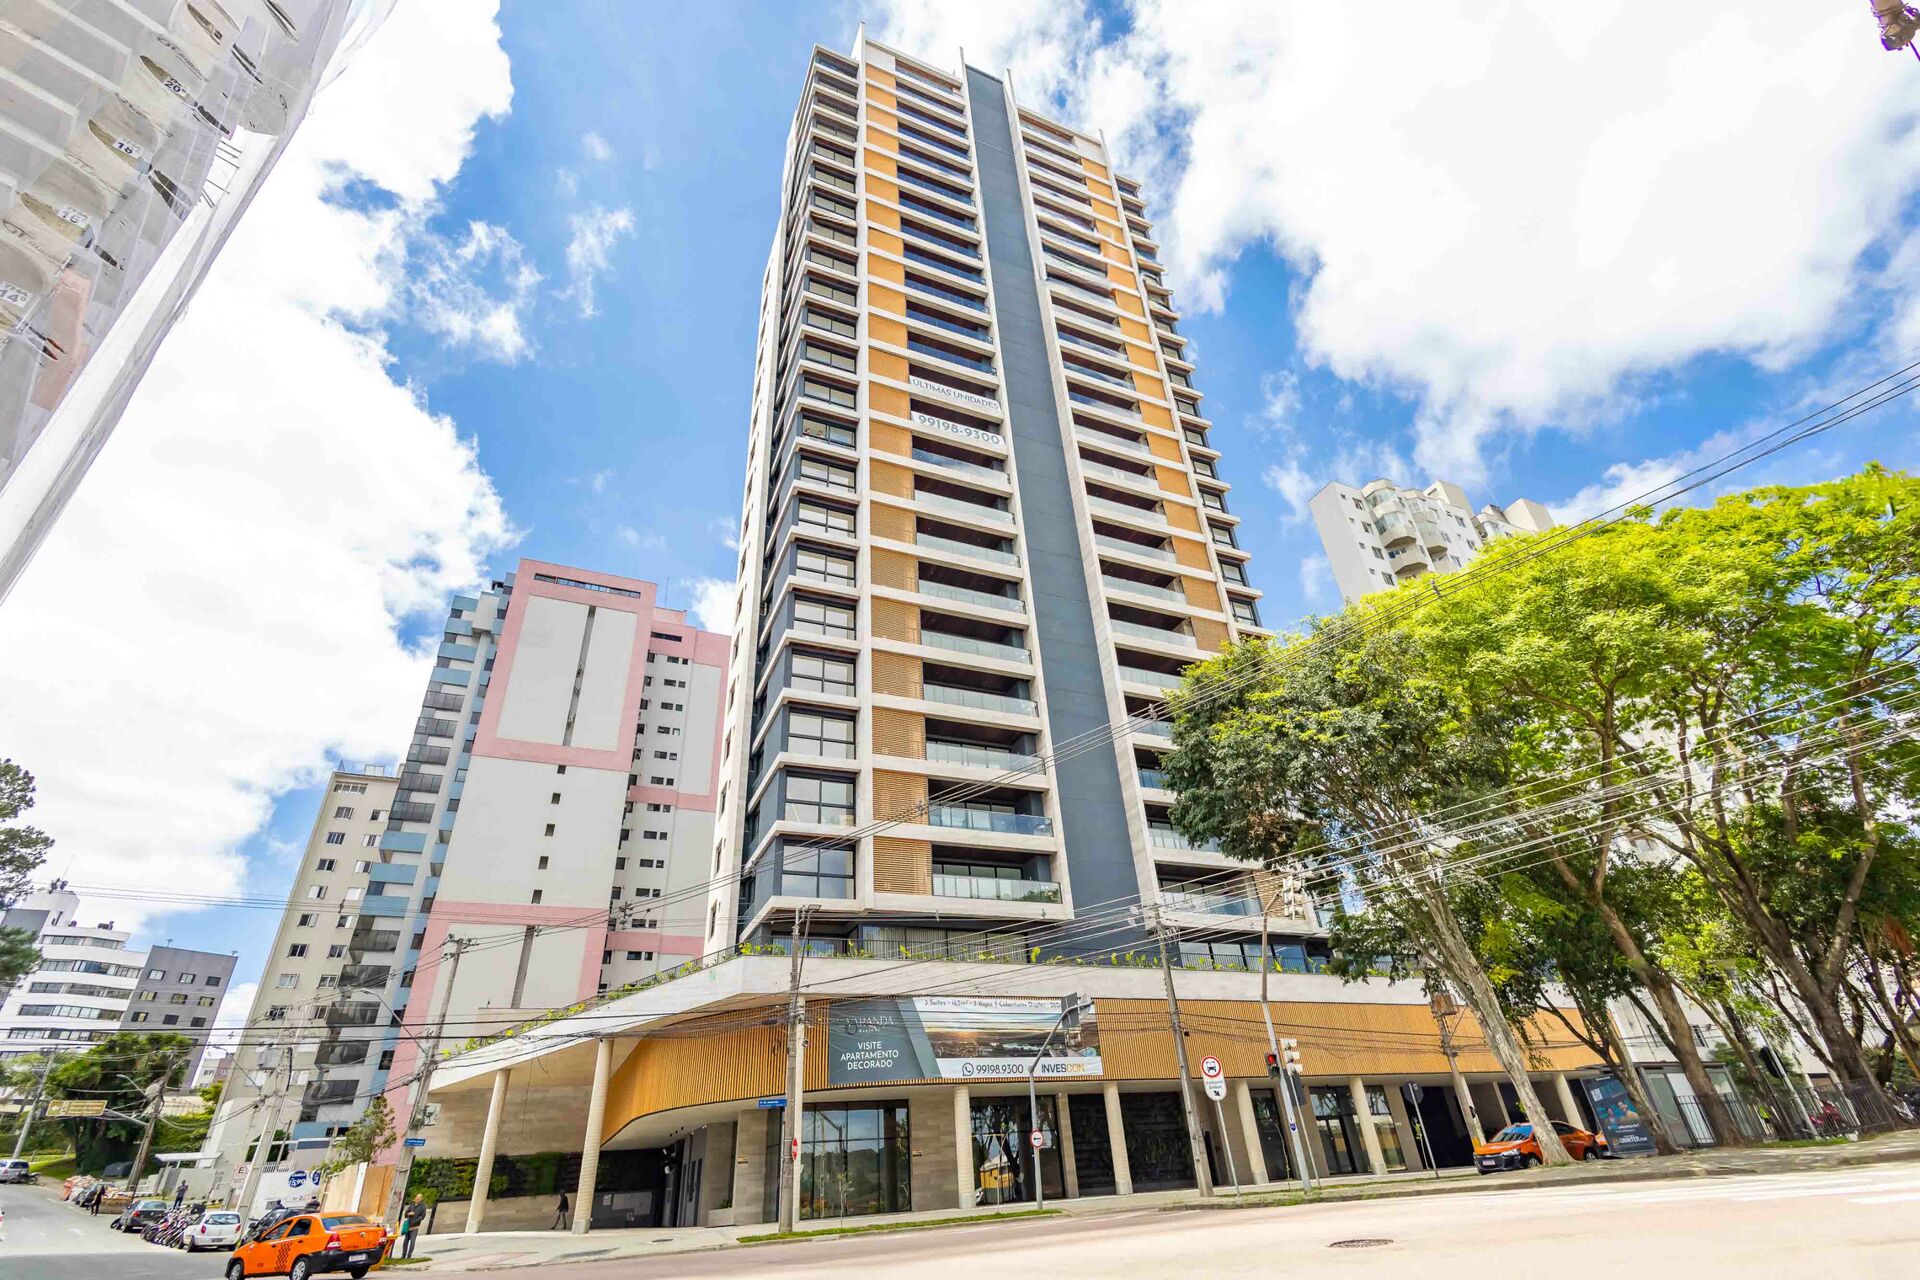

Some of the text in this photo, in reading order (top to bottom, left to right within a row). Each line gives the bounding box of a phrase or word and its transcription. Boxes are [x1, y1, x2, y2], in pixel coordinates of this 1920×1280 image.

[953, 391, 999, 410] UNIDADES
[918, 414, 1000, 445] 99198-9300
[857, 1041, 883, 1050] VISITE
[840, 1049, 899, 1061] APARTAMENTO
[847, 1059, 893, 1071] DECORADO
